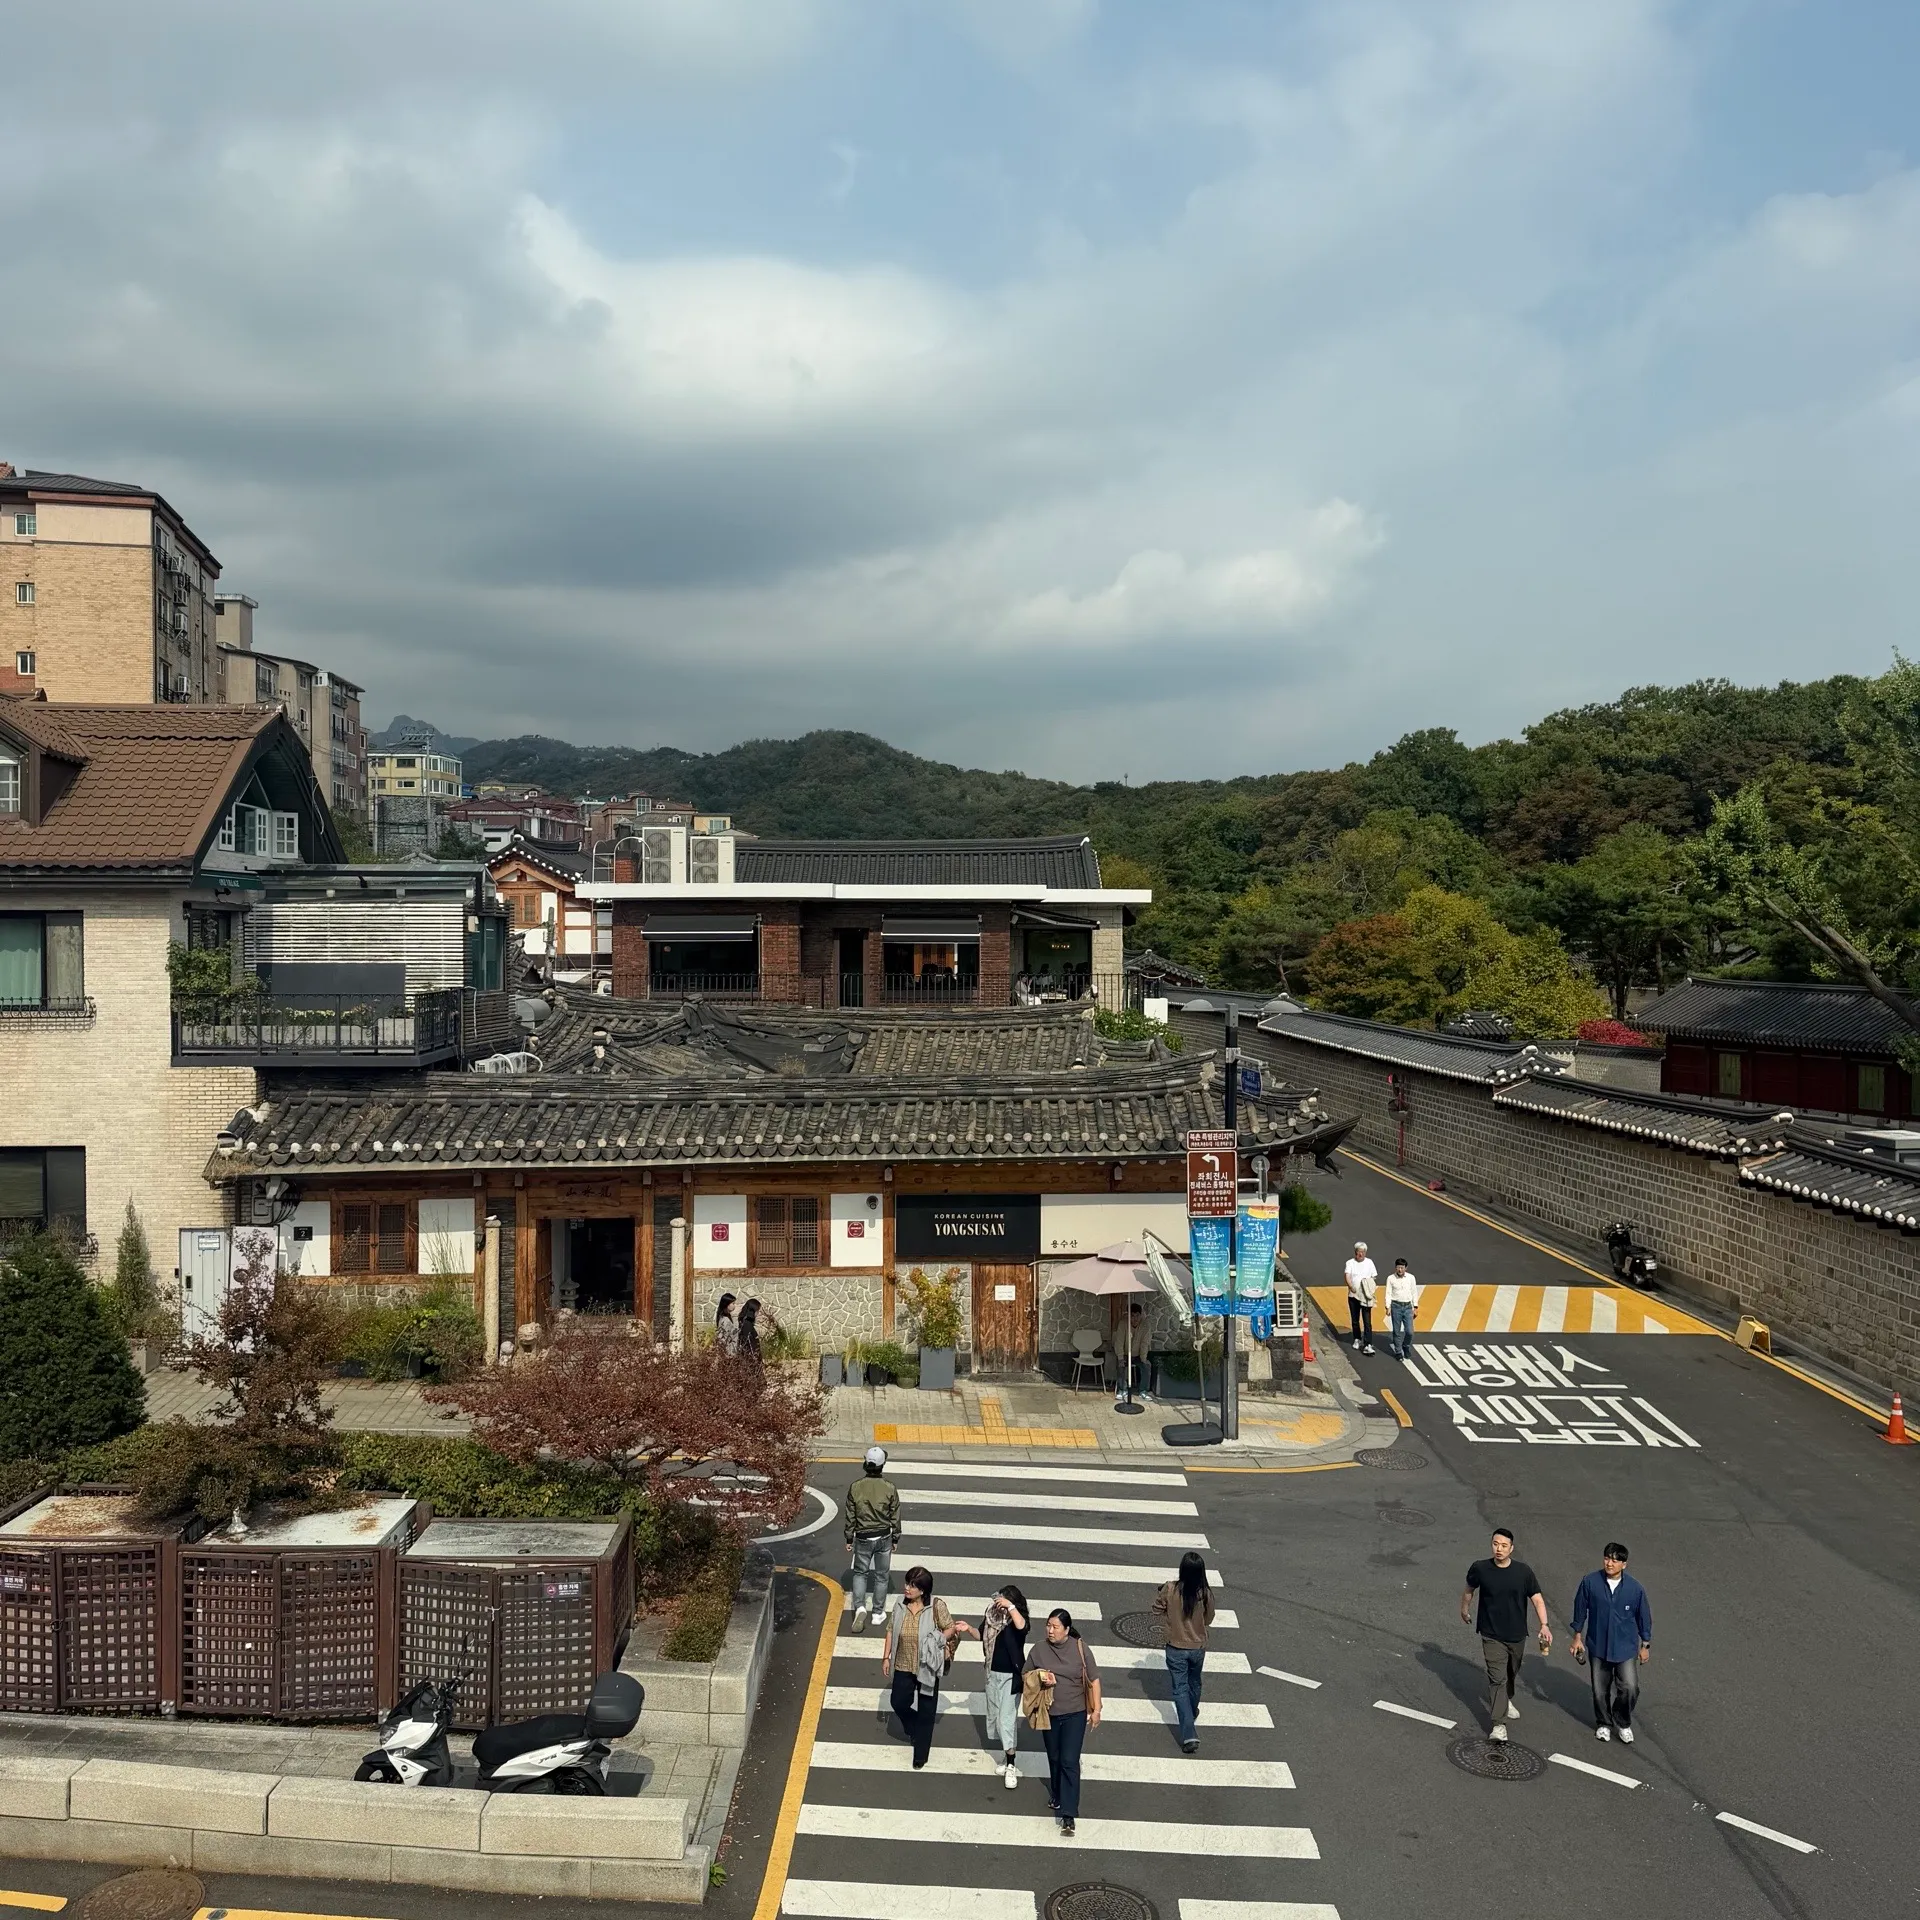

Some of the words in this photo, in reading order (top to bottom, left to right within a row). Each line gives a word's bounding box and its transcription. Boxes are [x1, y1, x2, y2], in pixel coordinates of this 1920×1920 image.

[1198, 1171, 1228, 1181] 좌회전시
[934, 1223, 1005, 1236] YONGSUSAN
[1050, 1239, 1078, 1249] 용수산
[1389, 1343, 1628, 1389] 대형버스
[1428, 1394, 1702, 1447] 진입금지
